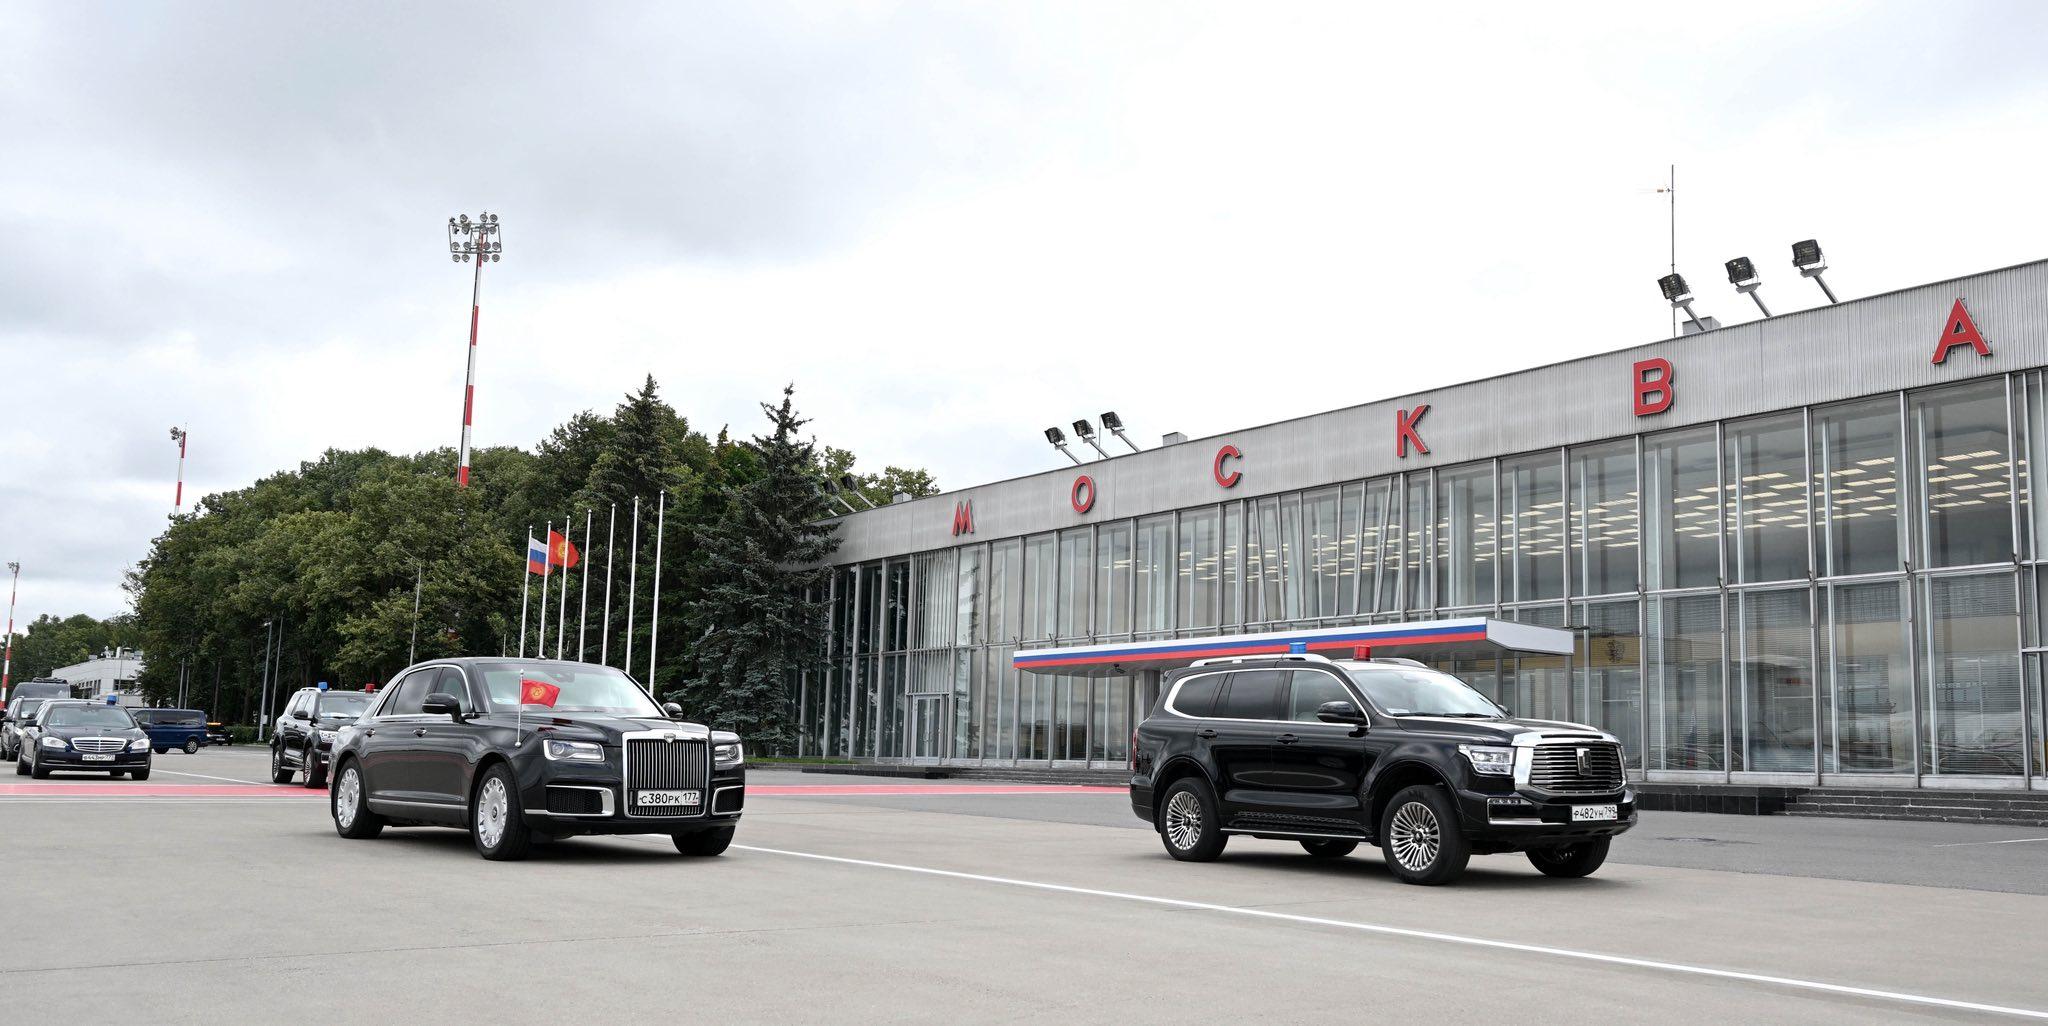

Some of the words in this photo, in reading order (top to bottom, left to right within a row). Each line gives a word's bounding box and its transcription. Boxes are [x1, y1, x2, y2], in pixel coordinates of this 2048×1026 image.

[952, 299, 1991, 535] МОСКВА
[641, 793, 680, 804] С380РК
[683, 792, 697, 801] 177
[1575, 807, 1603, 819] Р482УН
